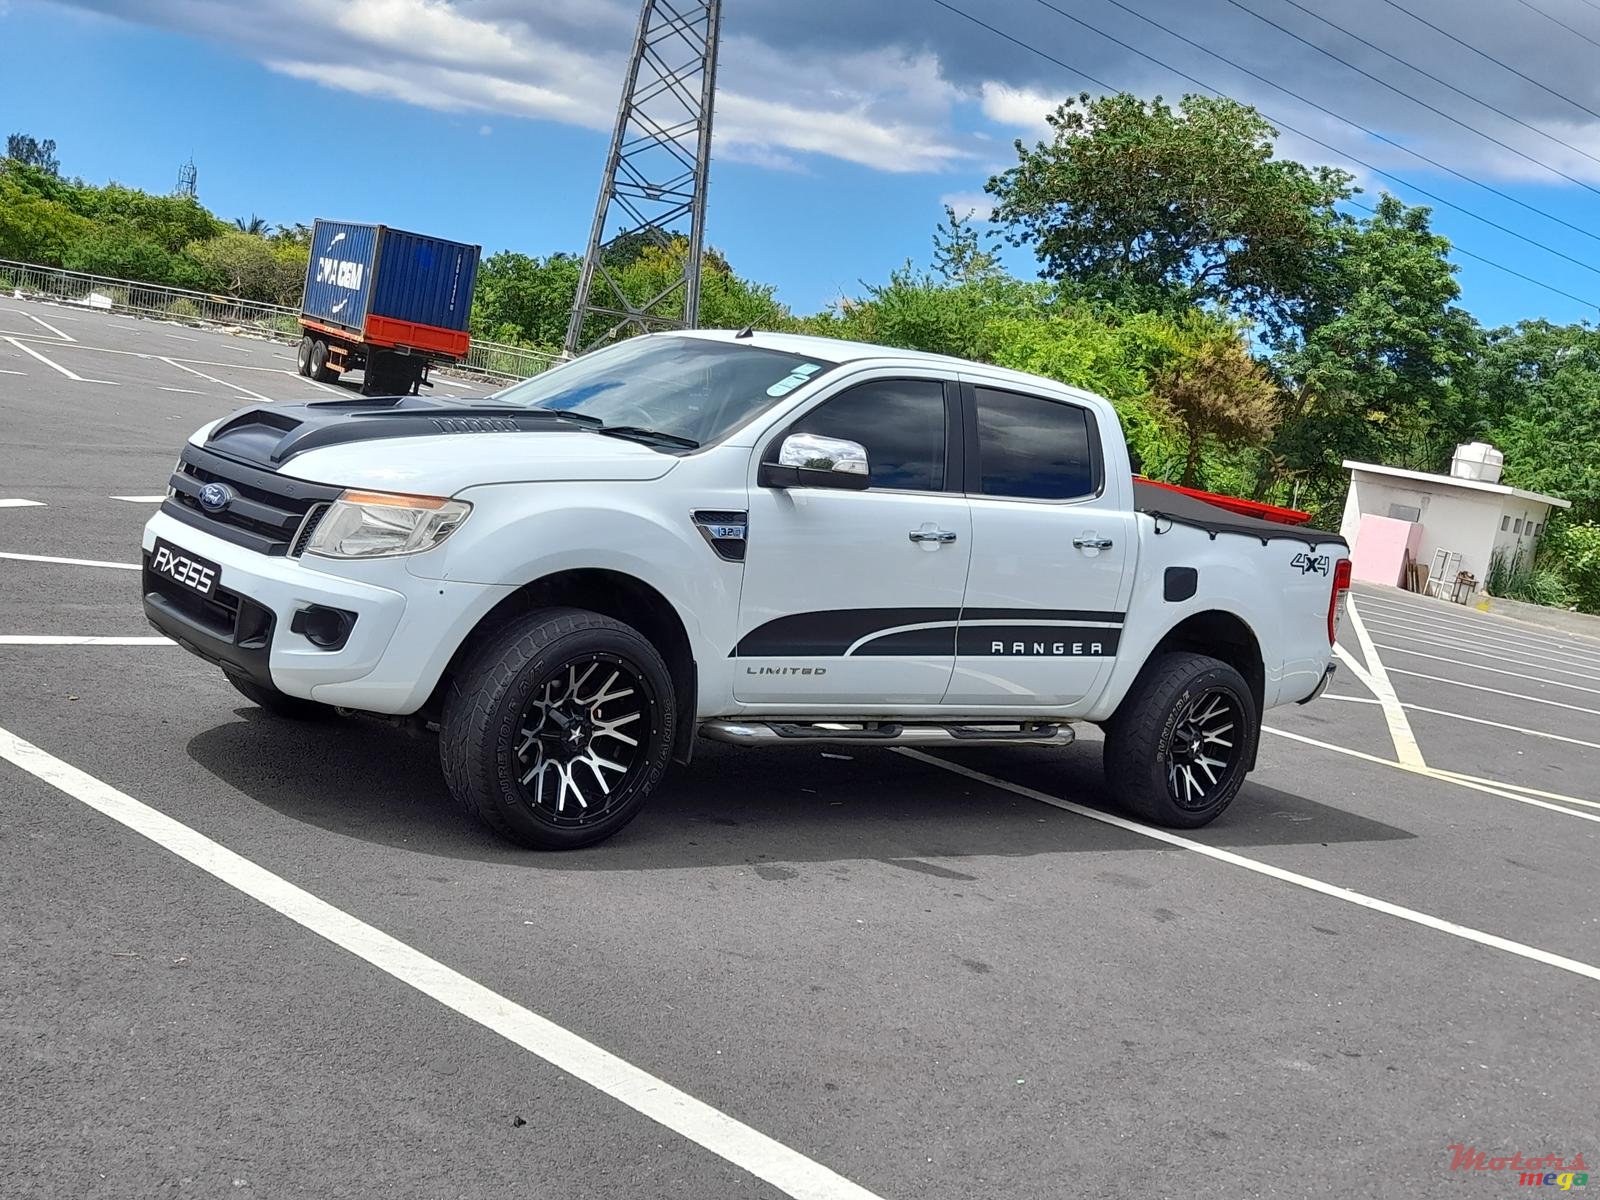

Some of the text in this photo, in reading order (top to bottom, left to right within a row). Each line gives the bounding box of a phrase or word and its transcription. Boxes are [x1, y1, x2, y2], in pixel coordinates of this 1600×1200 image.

[204, 486, 223, 504] Ford
[153, 546, 216, 594] AX355
[991, 641, 1102, 655] RANGER
[746, 666, 827, 676] LIMITED
